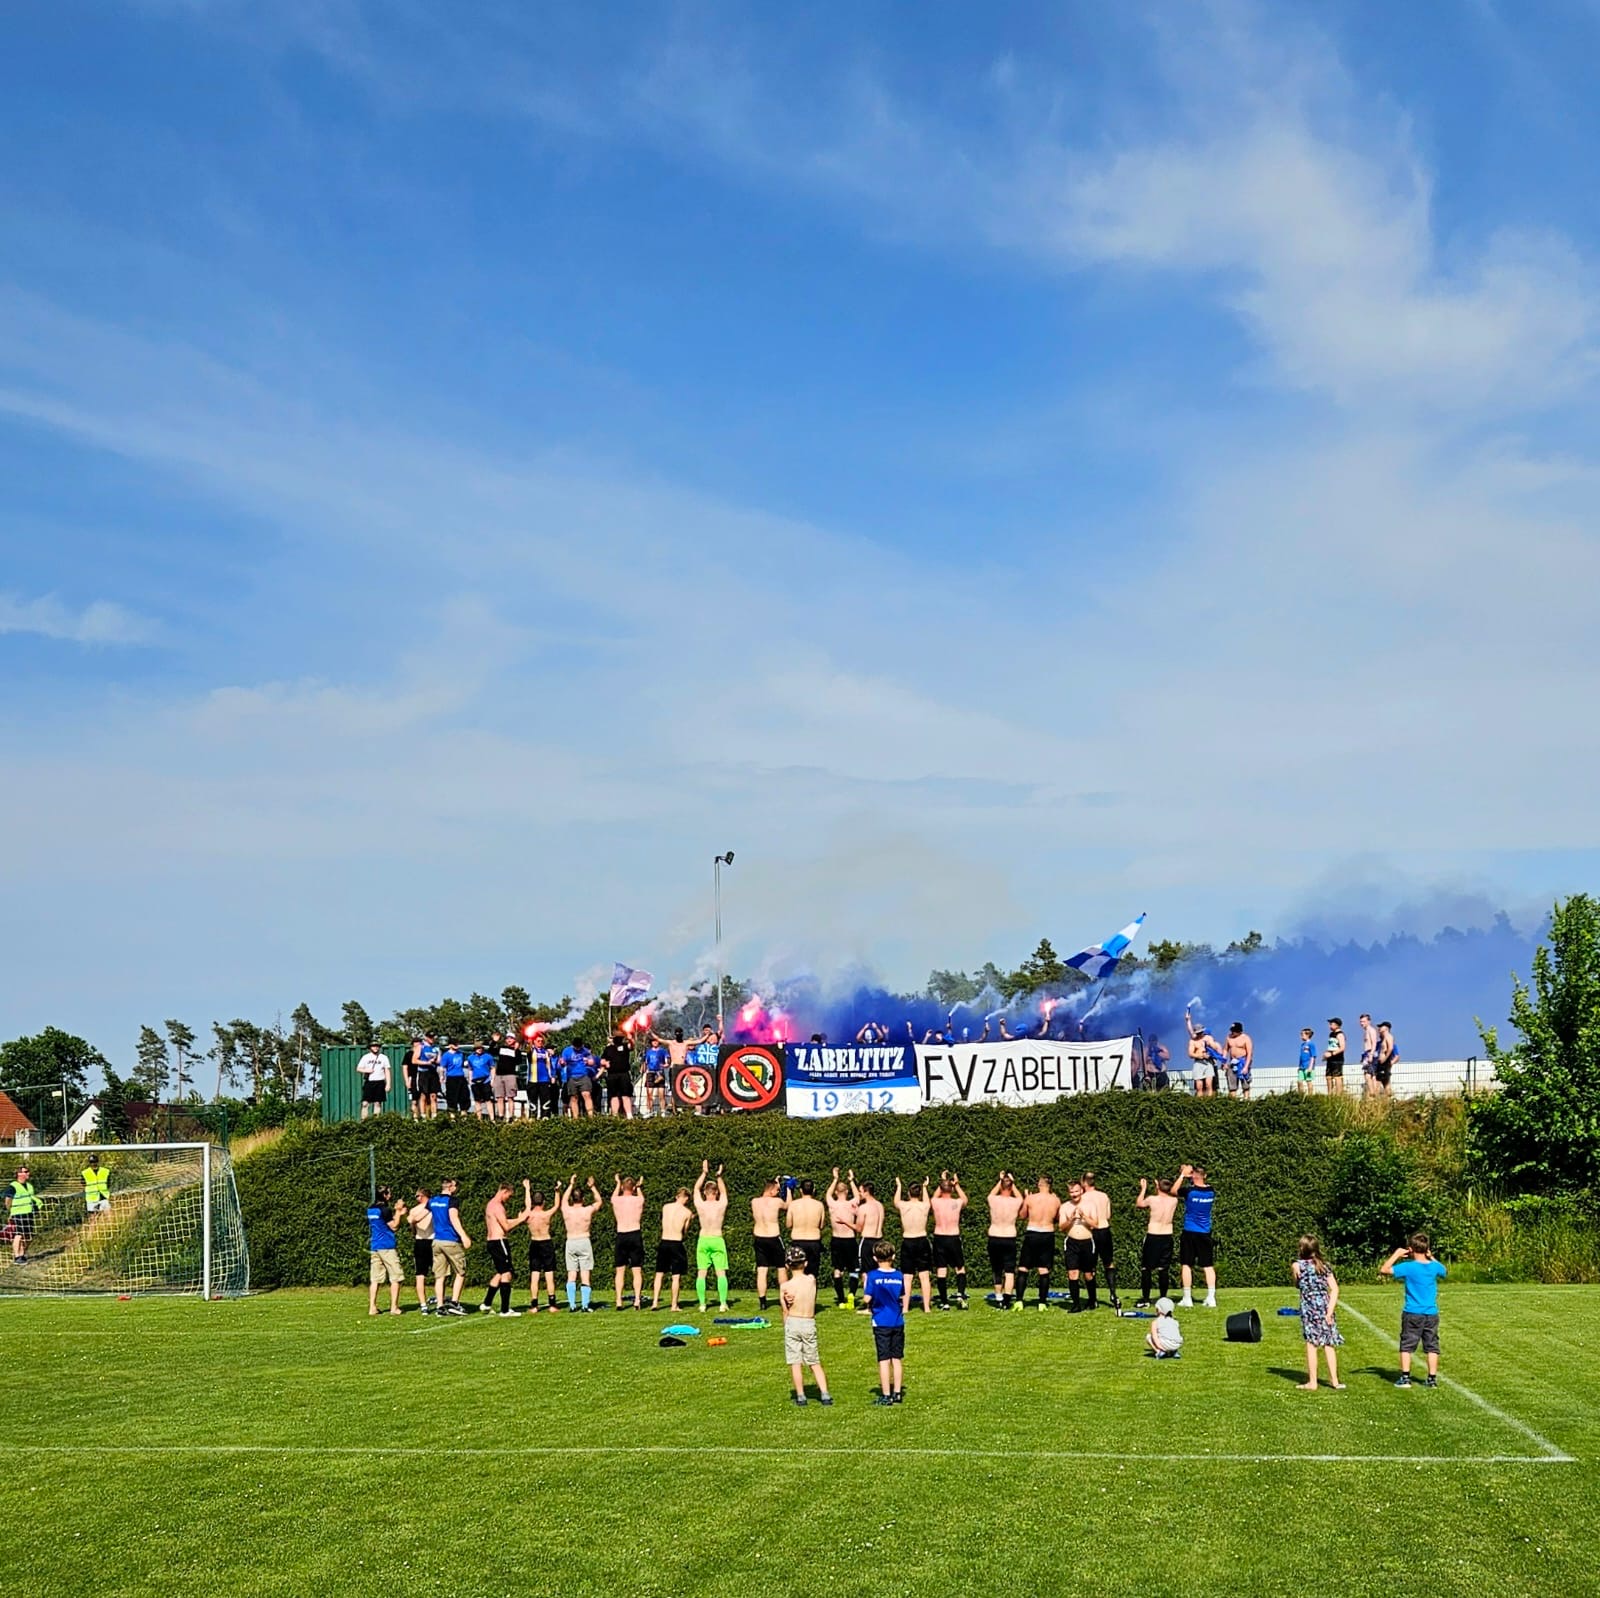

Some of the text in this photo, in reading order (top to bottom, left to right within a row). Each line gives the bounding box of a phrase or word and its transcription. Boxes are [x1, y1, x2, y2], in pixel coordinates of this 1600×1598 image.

[794, 1047, 905, 1072] ZABELTITZ
[924, 1054, 1124, 1101] FV ZABELTITZ
